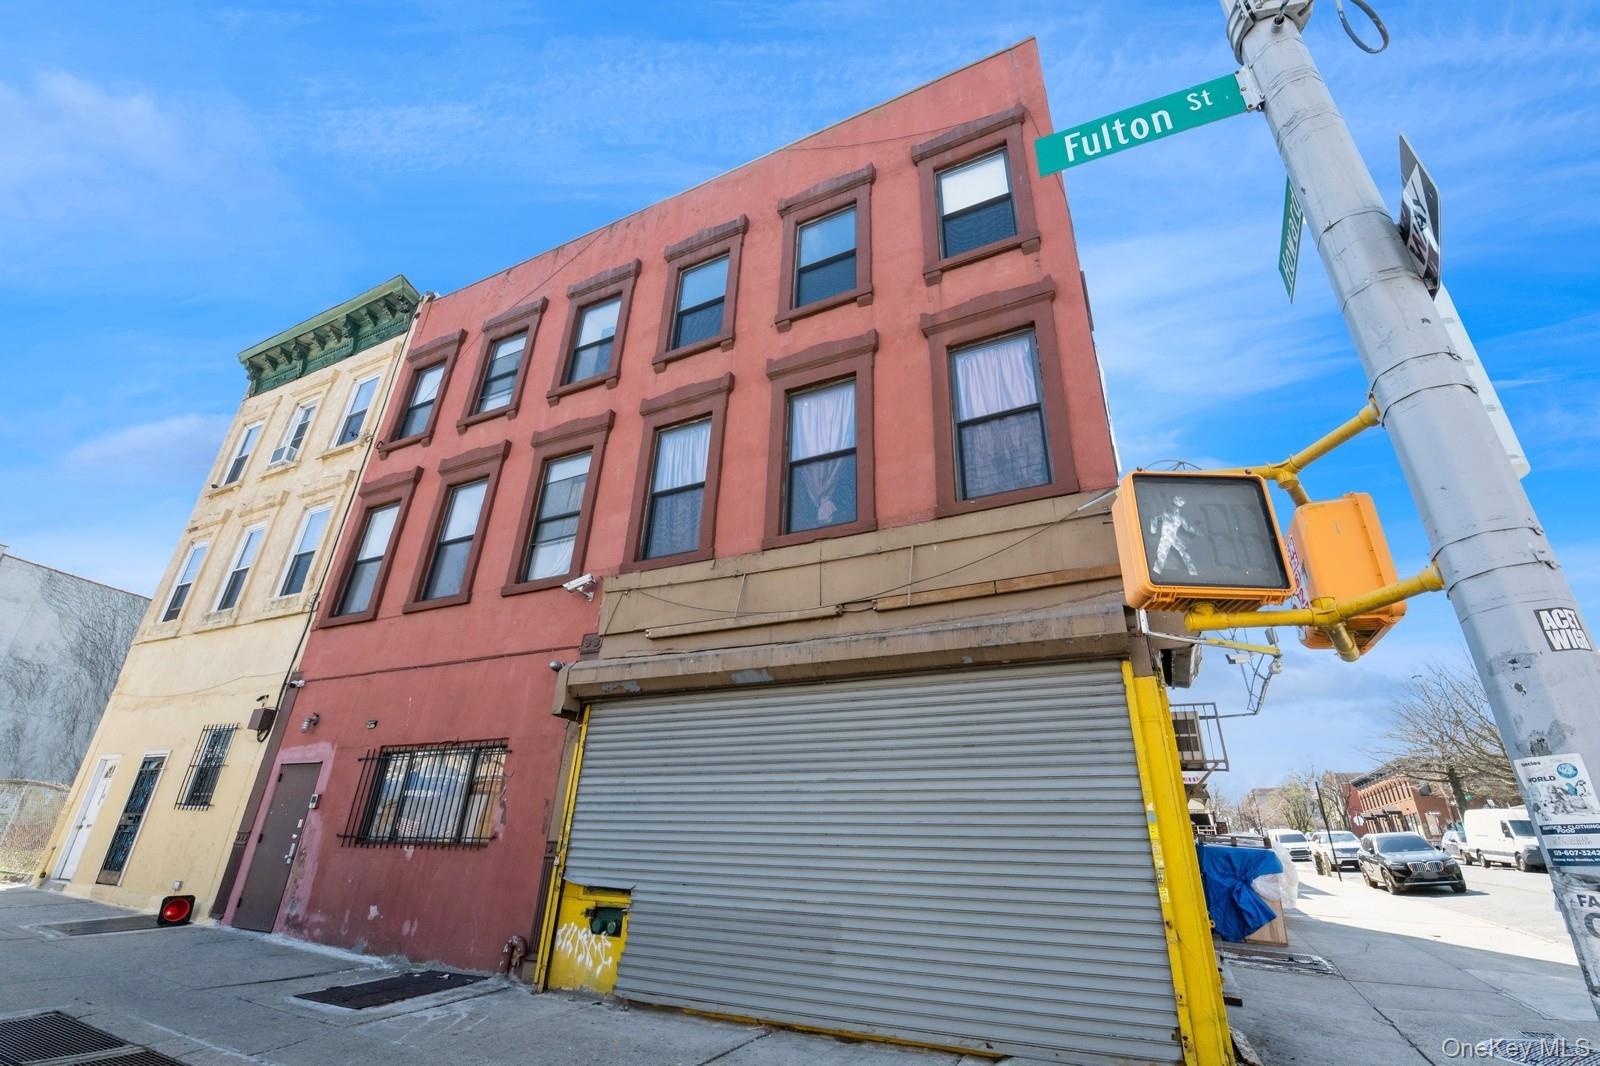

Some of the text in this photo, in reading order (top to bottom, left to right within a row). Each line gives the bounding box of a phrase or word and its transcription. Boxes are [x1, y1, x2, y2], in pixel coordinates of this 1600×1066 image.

[1064, 89, 1214, 162] Fulton St
[1281, 183, 1301, 290] Howard
